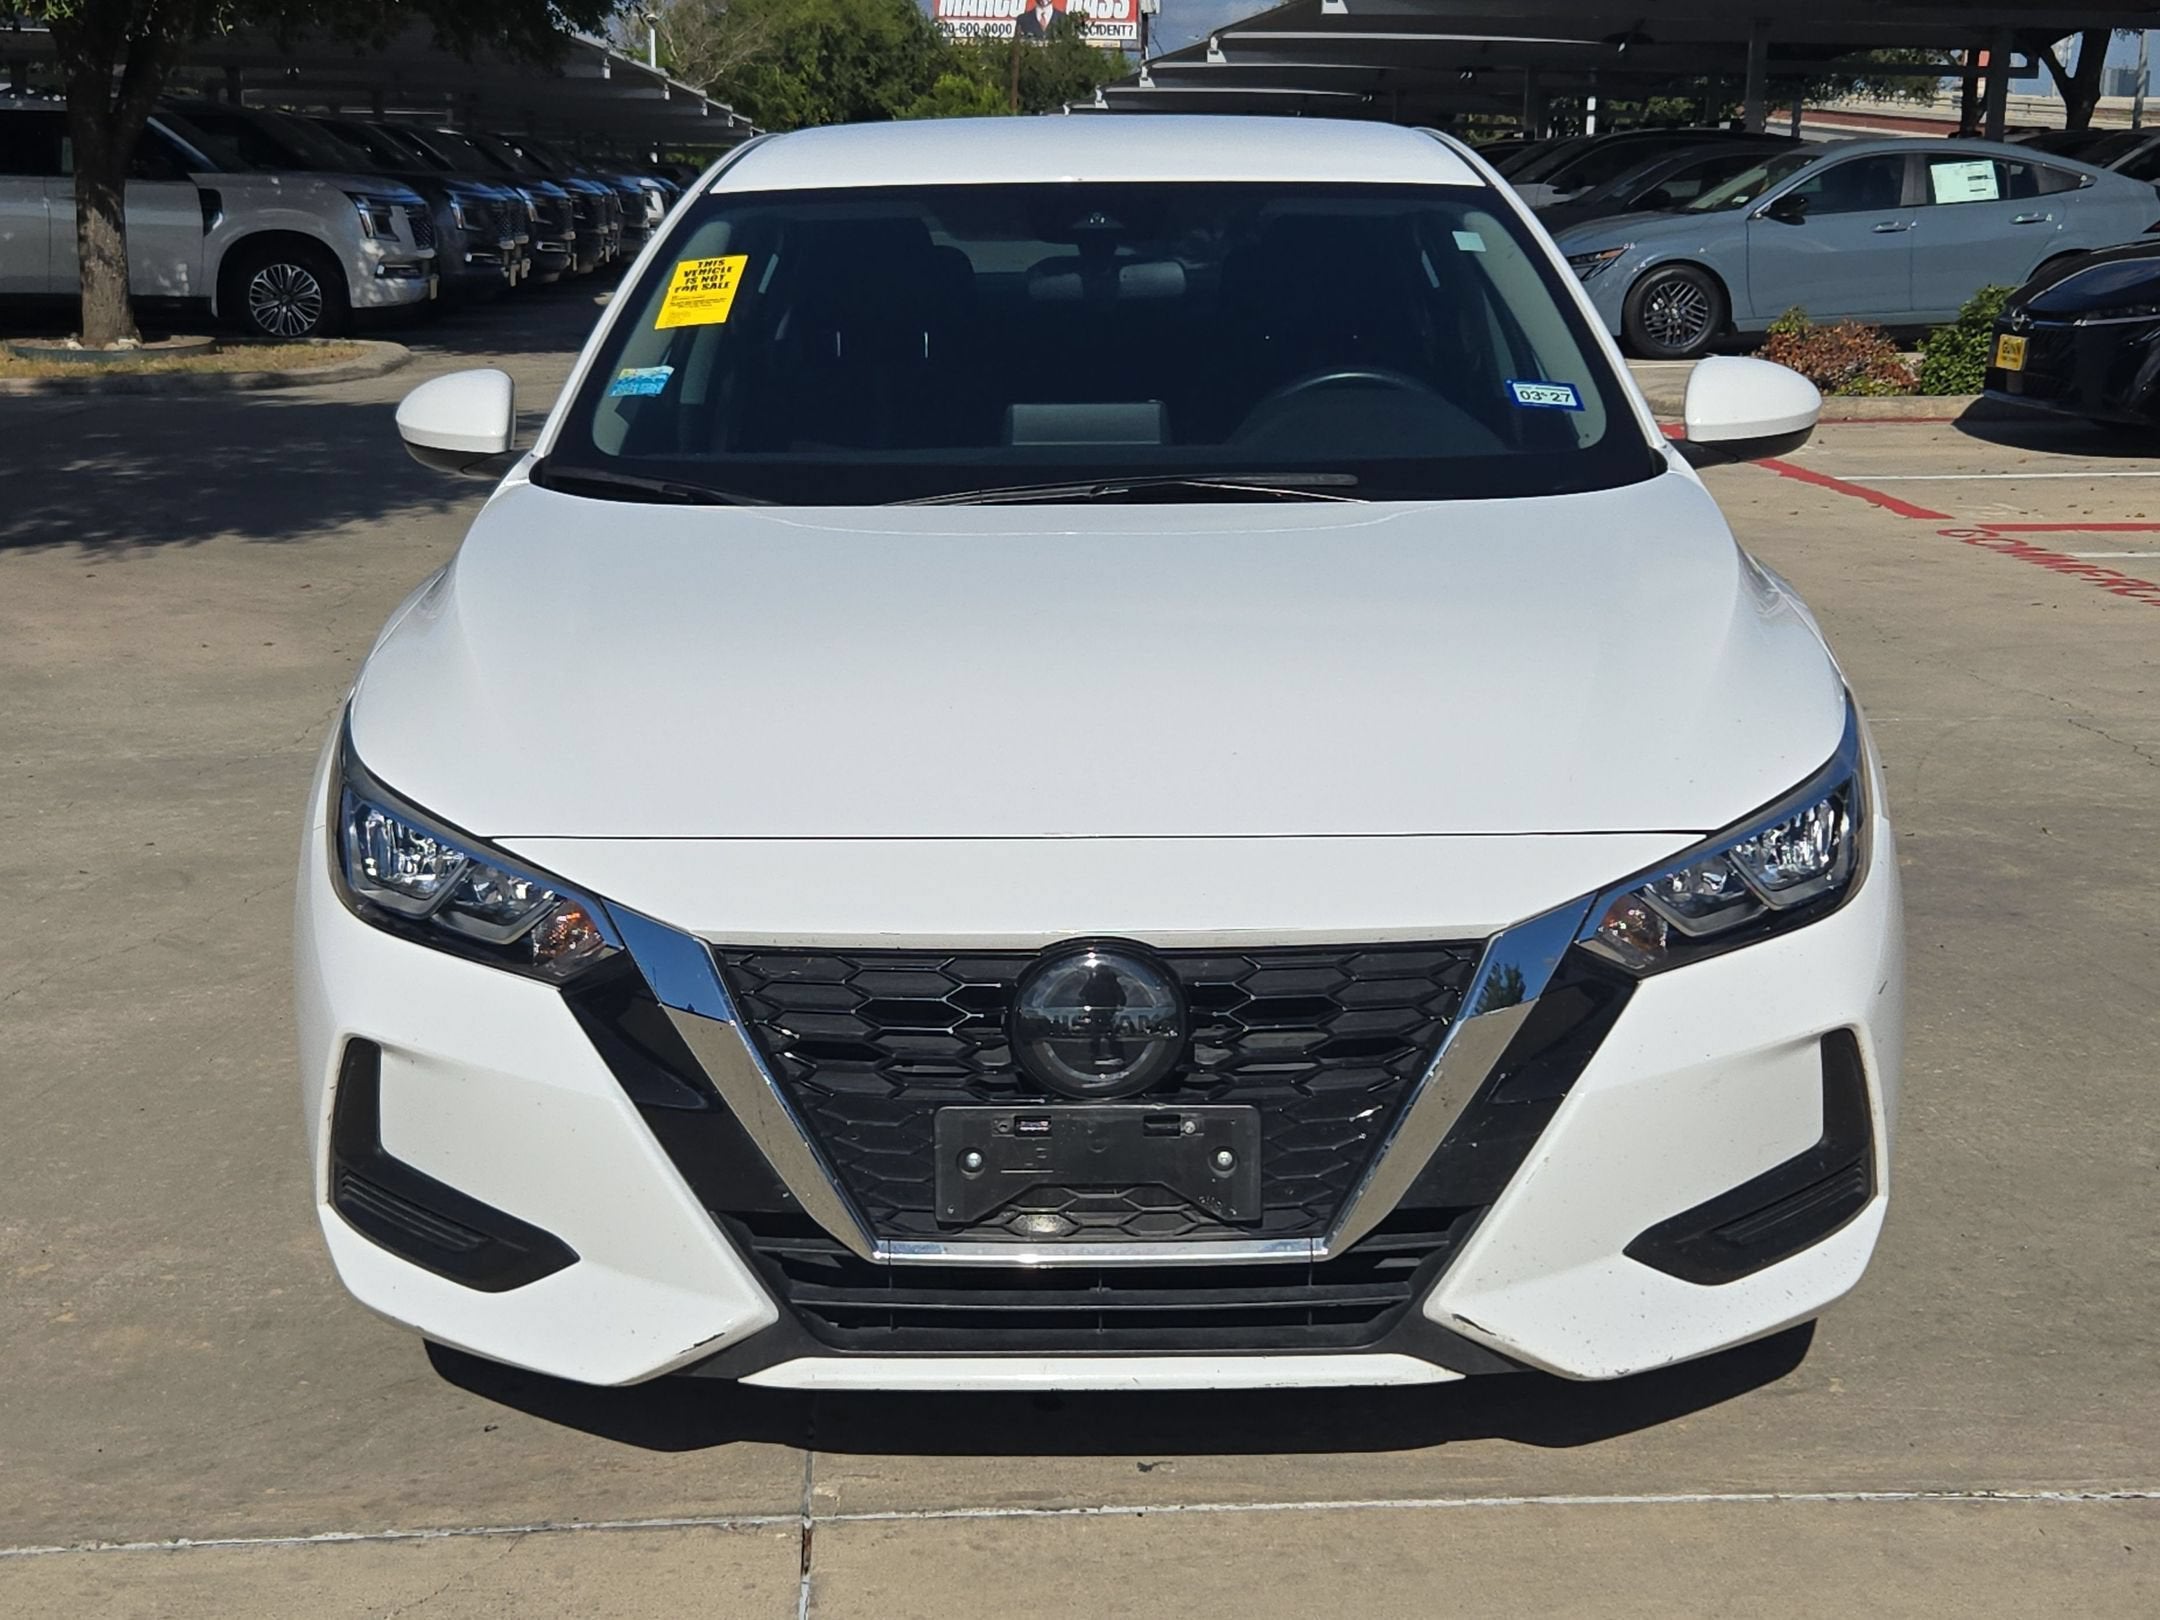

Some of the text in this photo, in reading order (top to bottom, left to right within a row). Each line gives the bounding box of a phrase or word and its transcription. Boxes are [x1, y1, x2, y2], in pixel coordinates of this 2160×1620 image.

[698, 260, 725, 268] THIS
[684, 266, 732, 277] VEHICLE
[701, 275, 725, 283] NOT
[674, 282, 730, 293] FOR SALE
[1520, 390, 1571, 403] 03 27
